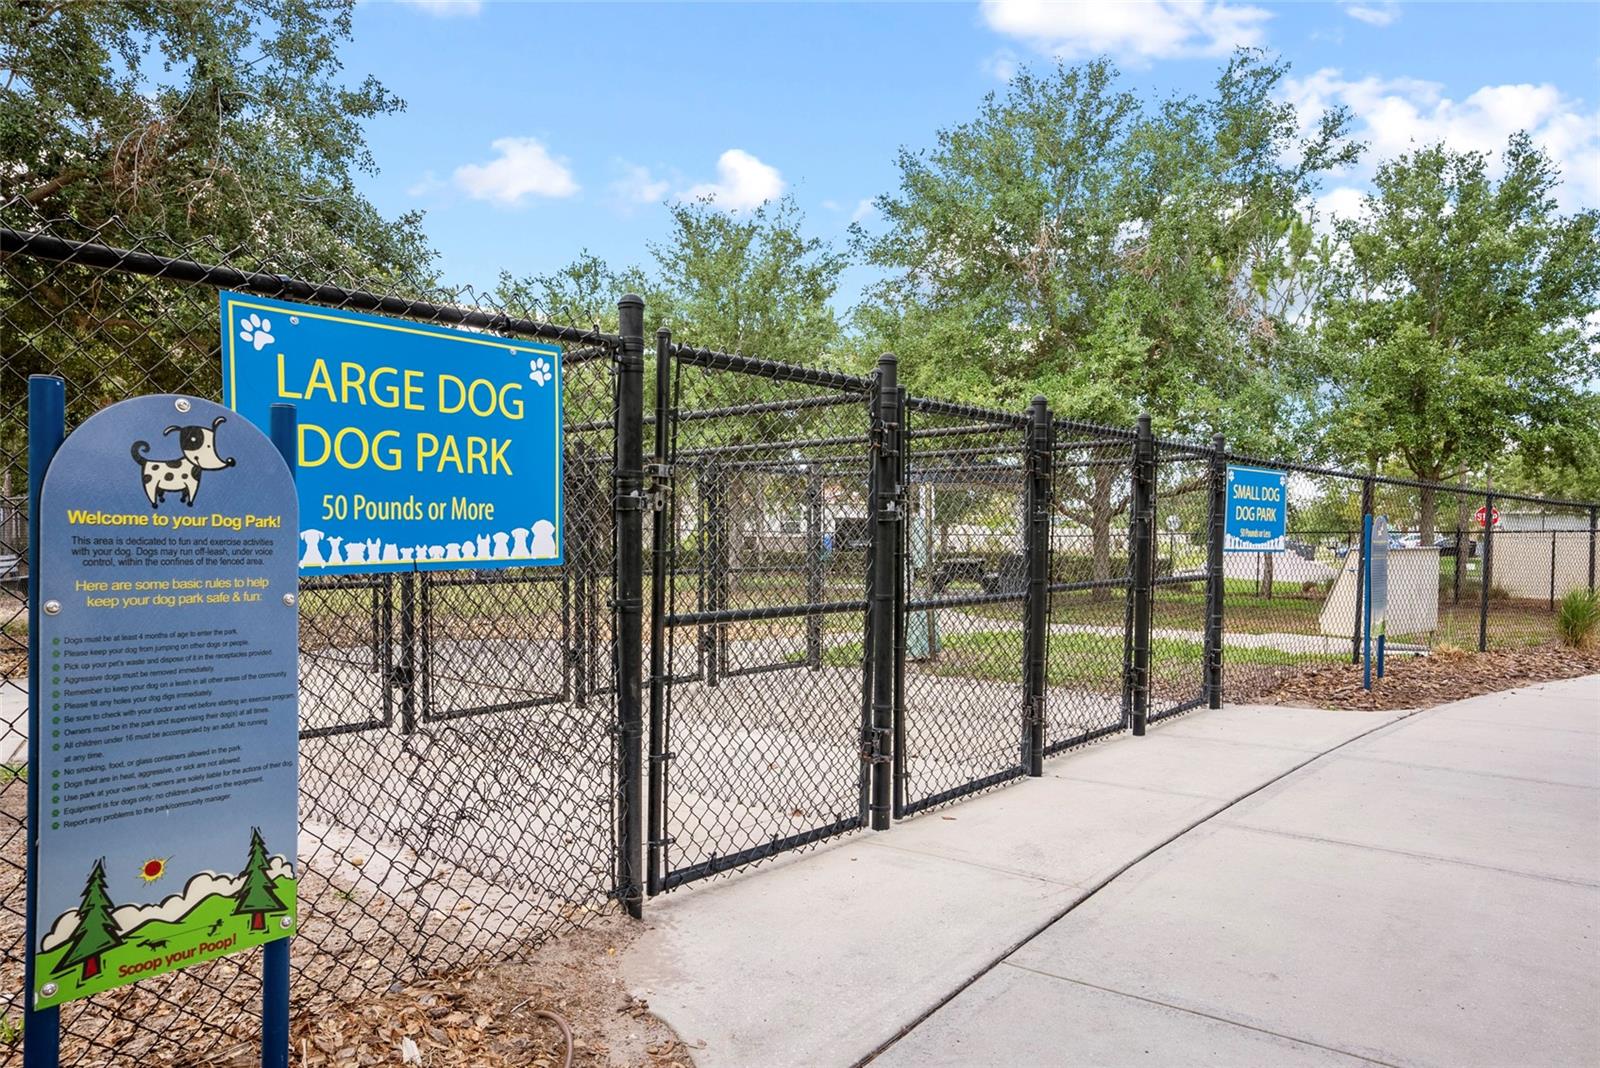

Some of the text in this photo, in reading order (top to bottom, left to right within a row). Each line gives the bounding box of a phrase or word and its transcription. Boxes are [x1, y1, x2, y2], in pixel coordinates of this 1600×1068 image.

[277, 354, 524, 420] LARGE DOG
[298, 424, 513, 476] DOG PARK
[1233, 484, 1280, 502] SMALL DOG
[322, 494, 494, 520] 50 Pounds or More
[1236, 506, 1276, 522] DOG PARK
[68, 510, 281, 530] Welcome to your Dog Park!
[1476, 512, 1498, 521] STP
[72, 536, 90, 545] This
[116, 537, 124, 545] is
[126, 537, 166, 545] dedicated
[169, 538, 176, 546] to
[178, 538, 192, 546] fun
[193, 538, 208, 546] and
[210, 538, 241, 546] exercise
[243, 538, 274, 546] activities
[72, 548, 90, 556] with
[92, 548, 112, 557] your
[136, 547, 158, 557] Dogs
[160, 549, 178, 557] may
[180, 548, 192, 556] run
[195, 547, 230, 556] off-leash,
[232, 548, 252, 556] under
[254, 548, 274, 556] voice
[82, 558, 116, 567] control,
[117, 558, 142, 566] within
[145, 558, 158, 566] the
[160, 558, 194, 566] confines
[196, 558, 204, 566] of
[206, 558, 218, 566] the
[219, 558, 244, 566] fenced
[76, 578, 270, 591] Here are some basic rules to help
[87, 596, 120, 608] keep
[122, 597, 150, 608] your
[153, 595, 176, 607] dog
[178, 593, 203, 606] park
[206, 592, 230, 603] safe
[232, 592, 240, 602] &
[155, 644, 179, 652] jumping
[133, 696, 147, 704] your
[162, 693, 174, 701] digs
[64, 728, 91, 736] Owners
[141, 720, 155, 728] park
[170, 714, 204, 723] supervising
[75, 739, 102, 747] children
[104, 736, 122, 744] under
[135, 732, 150, 740] must
[247, 718, 268, 726] running
[136, 758, 152, 766] glass
[188, 748, 210, 757] allowed
[85, 777, 97, 785] that
[64, 818, 88, 827] Report
[103, 811, 134, 821] problems
[118, 934, 237, 978] Scoop your Poop!
